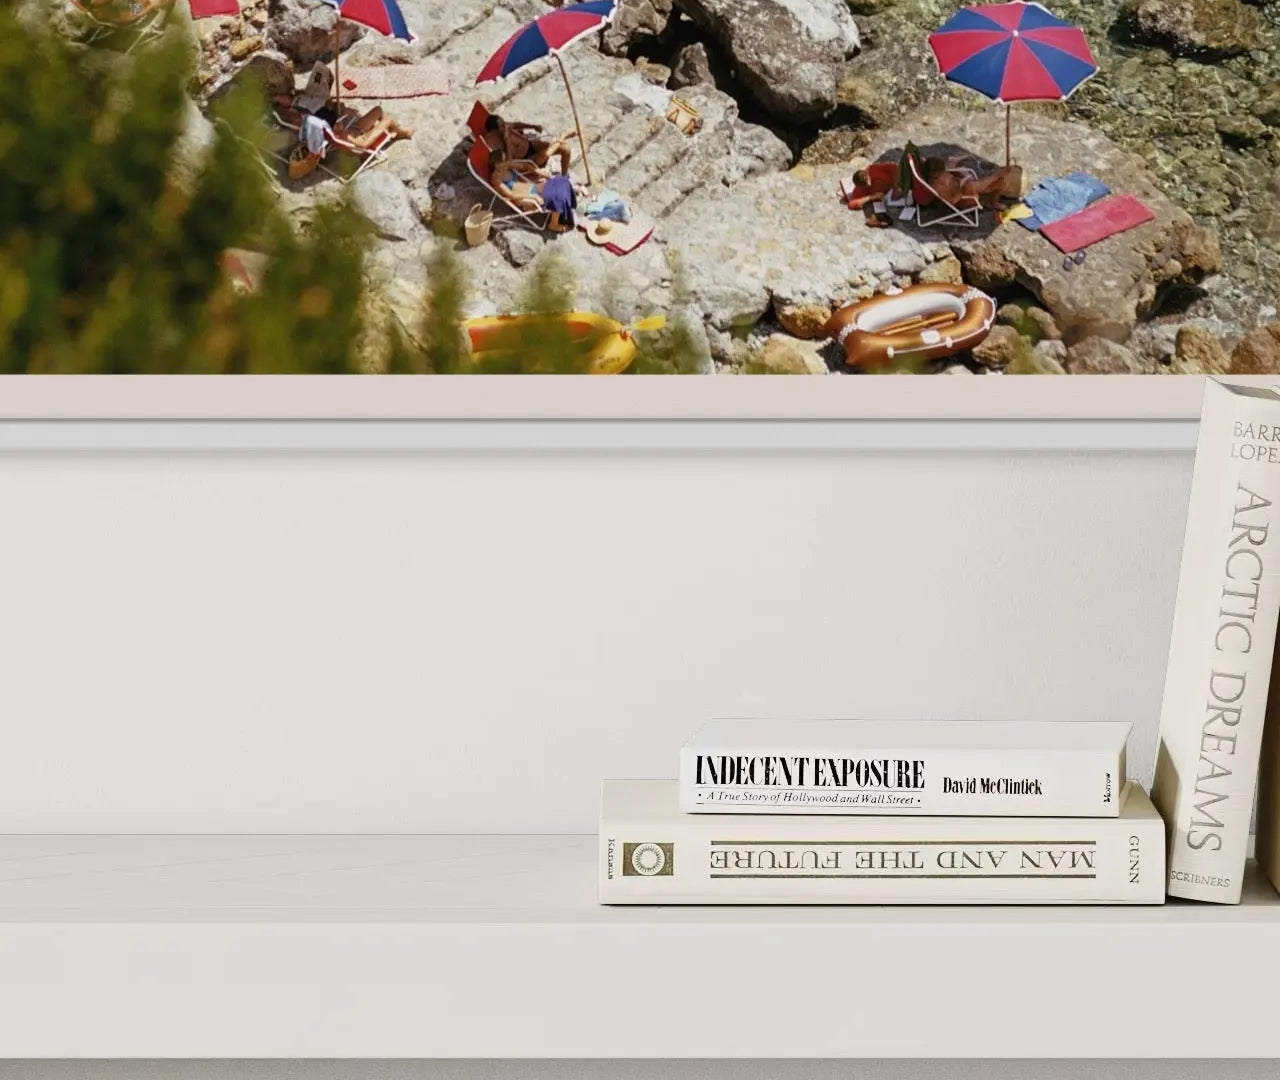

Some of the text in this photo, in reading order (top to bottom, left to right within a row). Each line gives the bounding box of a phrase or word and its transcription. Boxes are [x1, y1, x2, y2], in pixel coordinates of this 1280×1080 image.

[1186, 480, 1273, 852] ARCTIC DREAMS
[695, 755, 925, 789] INDECENT EXPOSURE
[943, 776, 1043, 796] David McClintick
[716, 791, 741, 803] True
[741, 791, 770, 805] Story
[769, 791, 782, 806] of
[782, 792, 839, 806] Hollywood
[839, 794, 860, 806] and
[861, 794, 886, 806] Wall
[885, 794, 915, 806] Street
[710, 850, 1097, 870] MAN AND THE FUTURE
[1128, 835, 1140, 884] GUNN
[1170, 870, 1231, 888] SCRIBNERS
